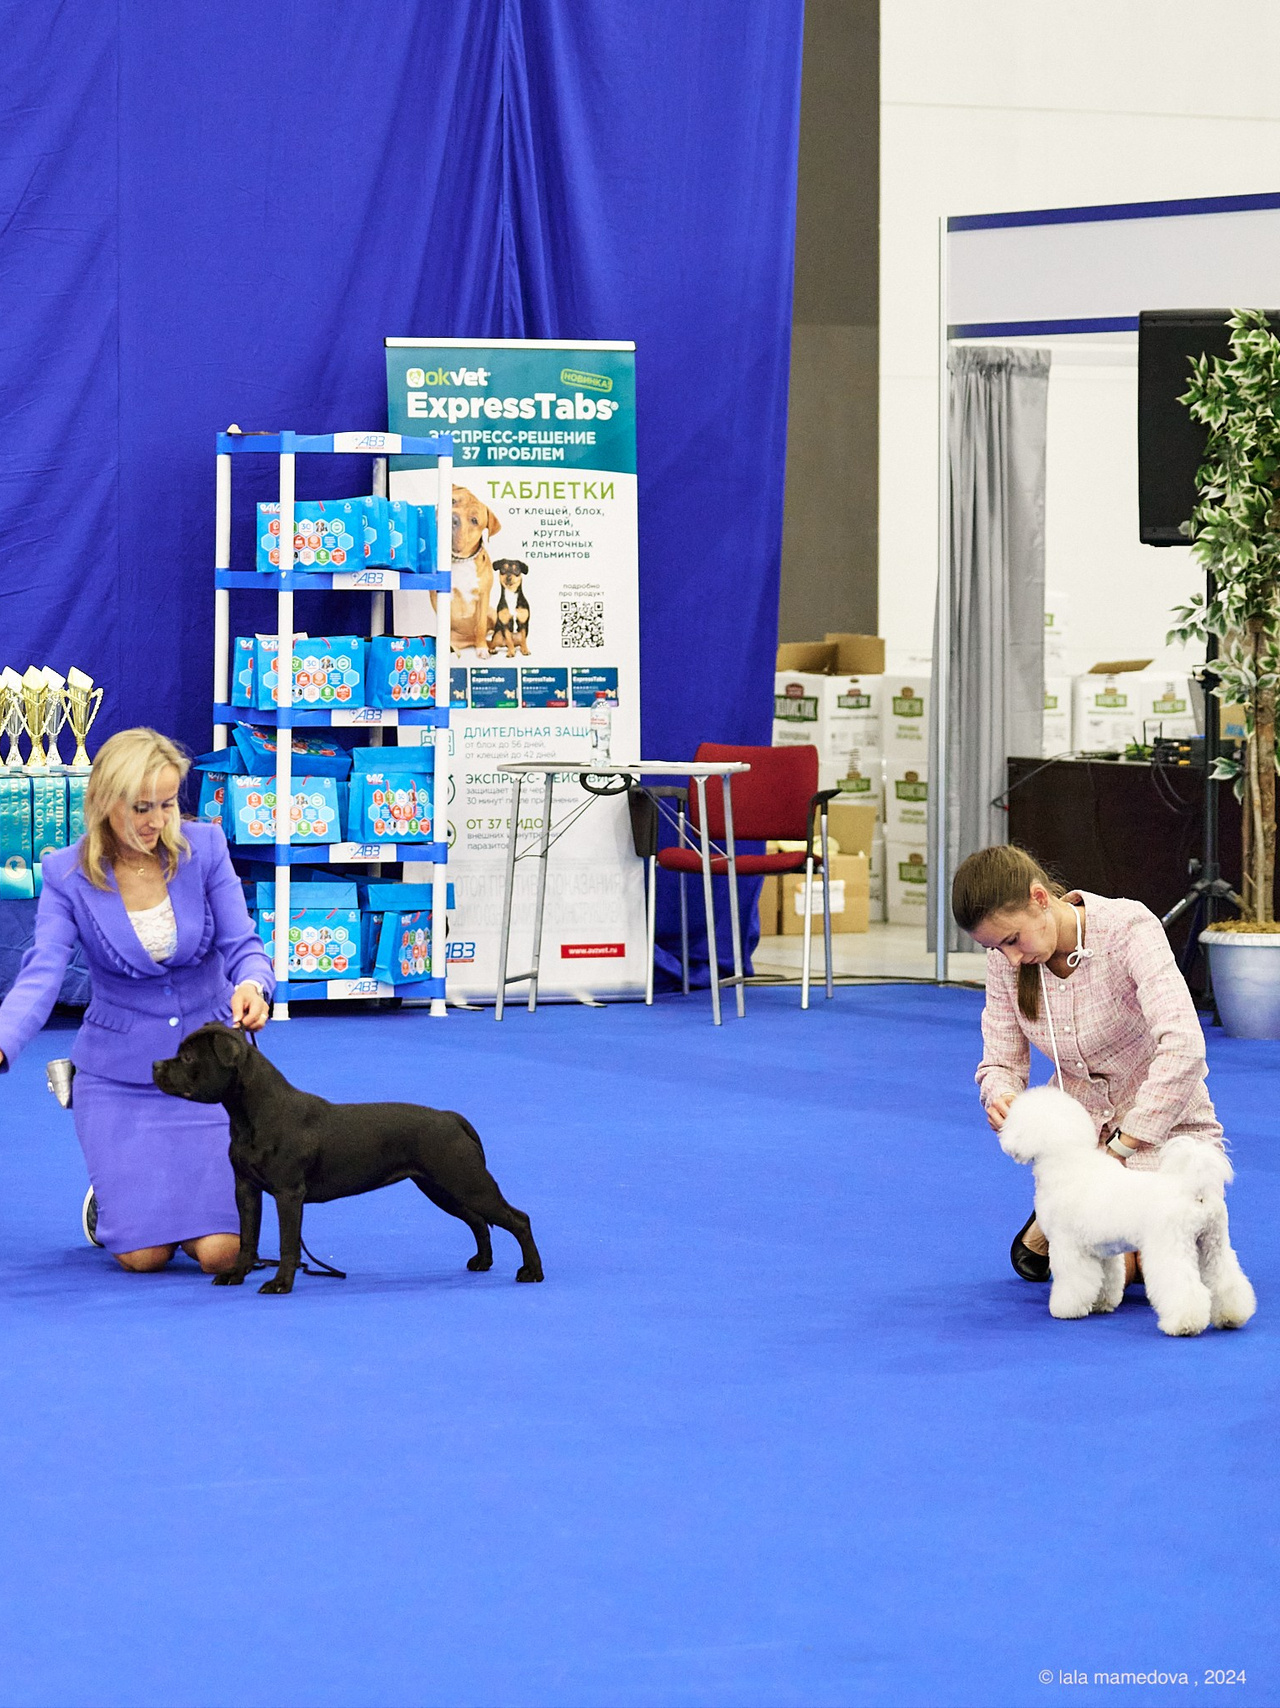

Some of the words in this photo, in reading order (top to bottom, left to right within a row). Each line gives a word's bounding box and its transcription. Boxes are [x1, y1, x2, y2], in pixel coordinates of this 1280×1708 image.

[462, 447, 480, 460] 37
[487, 447, 565, 460] ПРОБЛЕМ
[487, 480, 615, 500] ТАБЛЕТКИ
[509, 507, 520, 515] от
[524, 505, 572, 517] клещей,
[575, 506, 605, 517] блох,
[540, 516, 573, 527] вшей,
[533, 528, 580, 538] круглых
[522, 540, 529, 548] и
[531, 540, 593, 548] ленточных
[525, 550, 590, 559] гельминтов
[464, 727, 551, 739] ДЛИТЕЛЬНАЯ
[555, 726, 593, 738] ЗАЩИ
[466, 818, 483, 829] ОТ
[488, 818, 502, 829] 37
